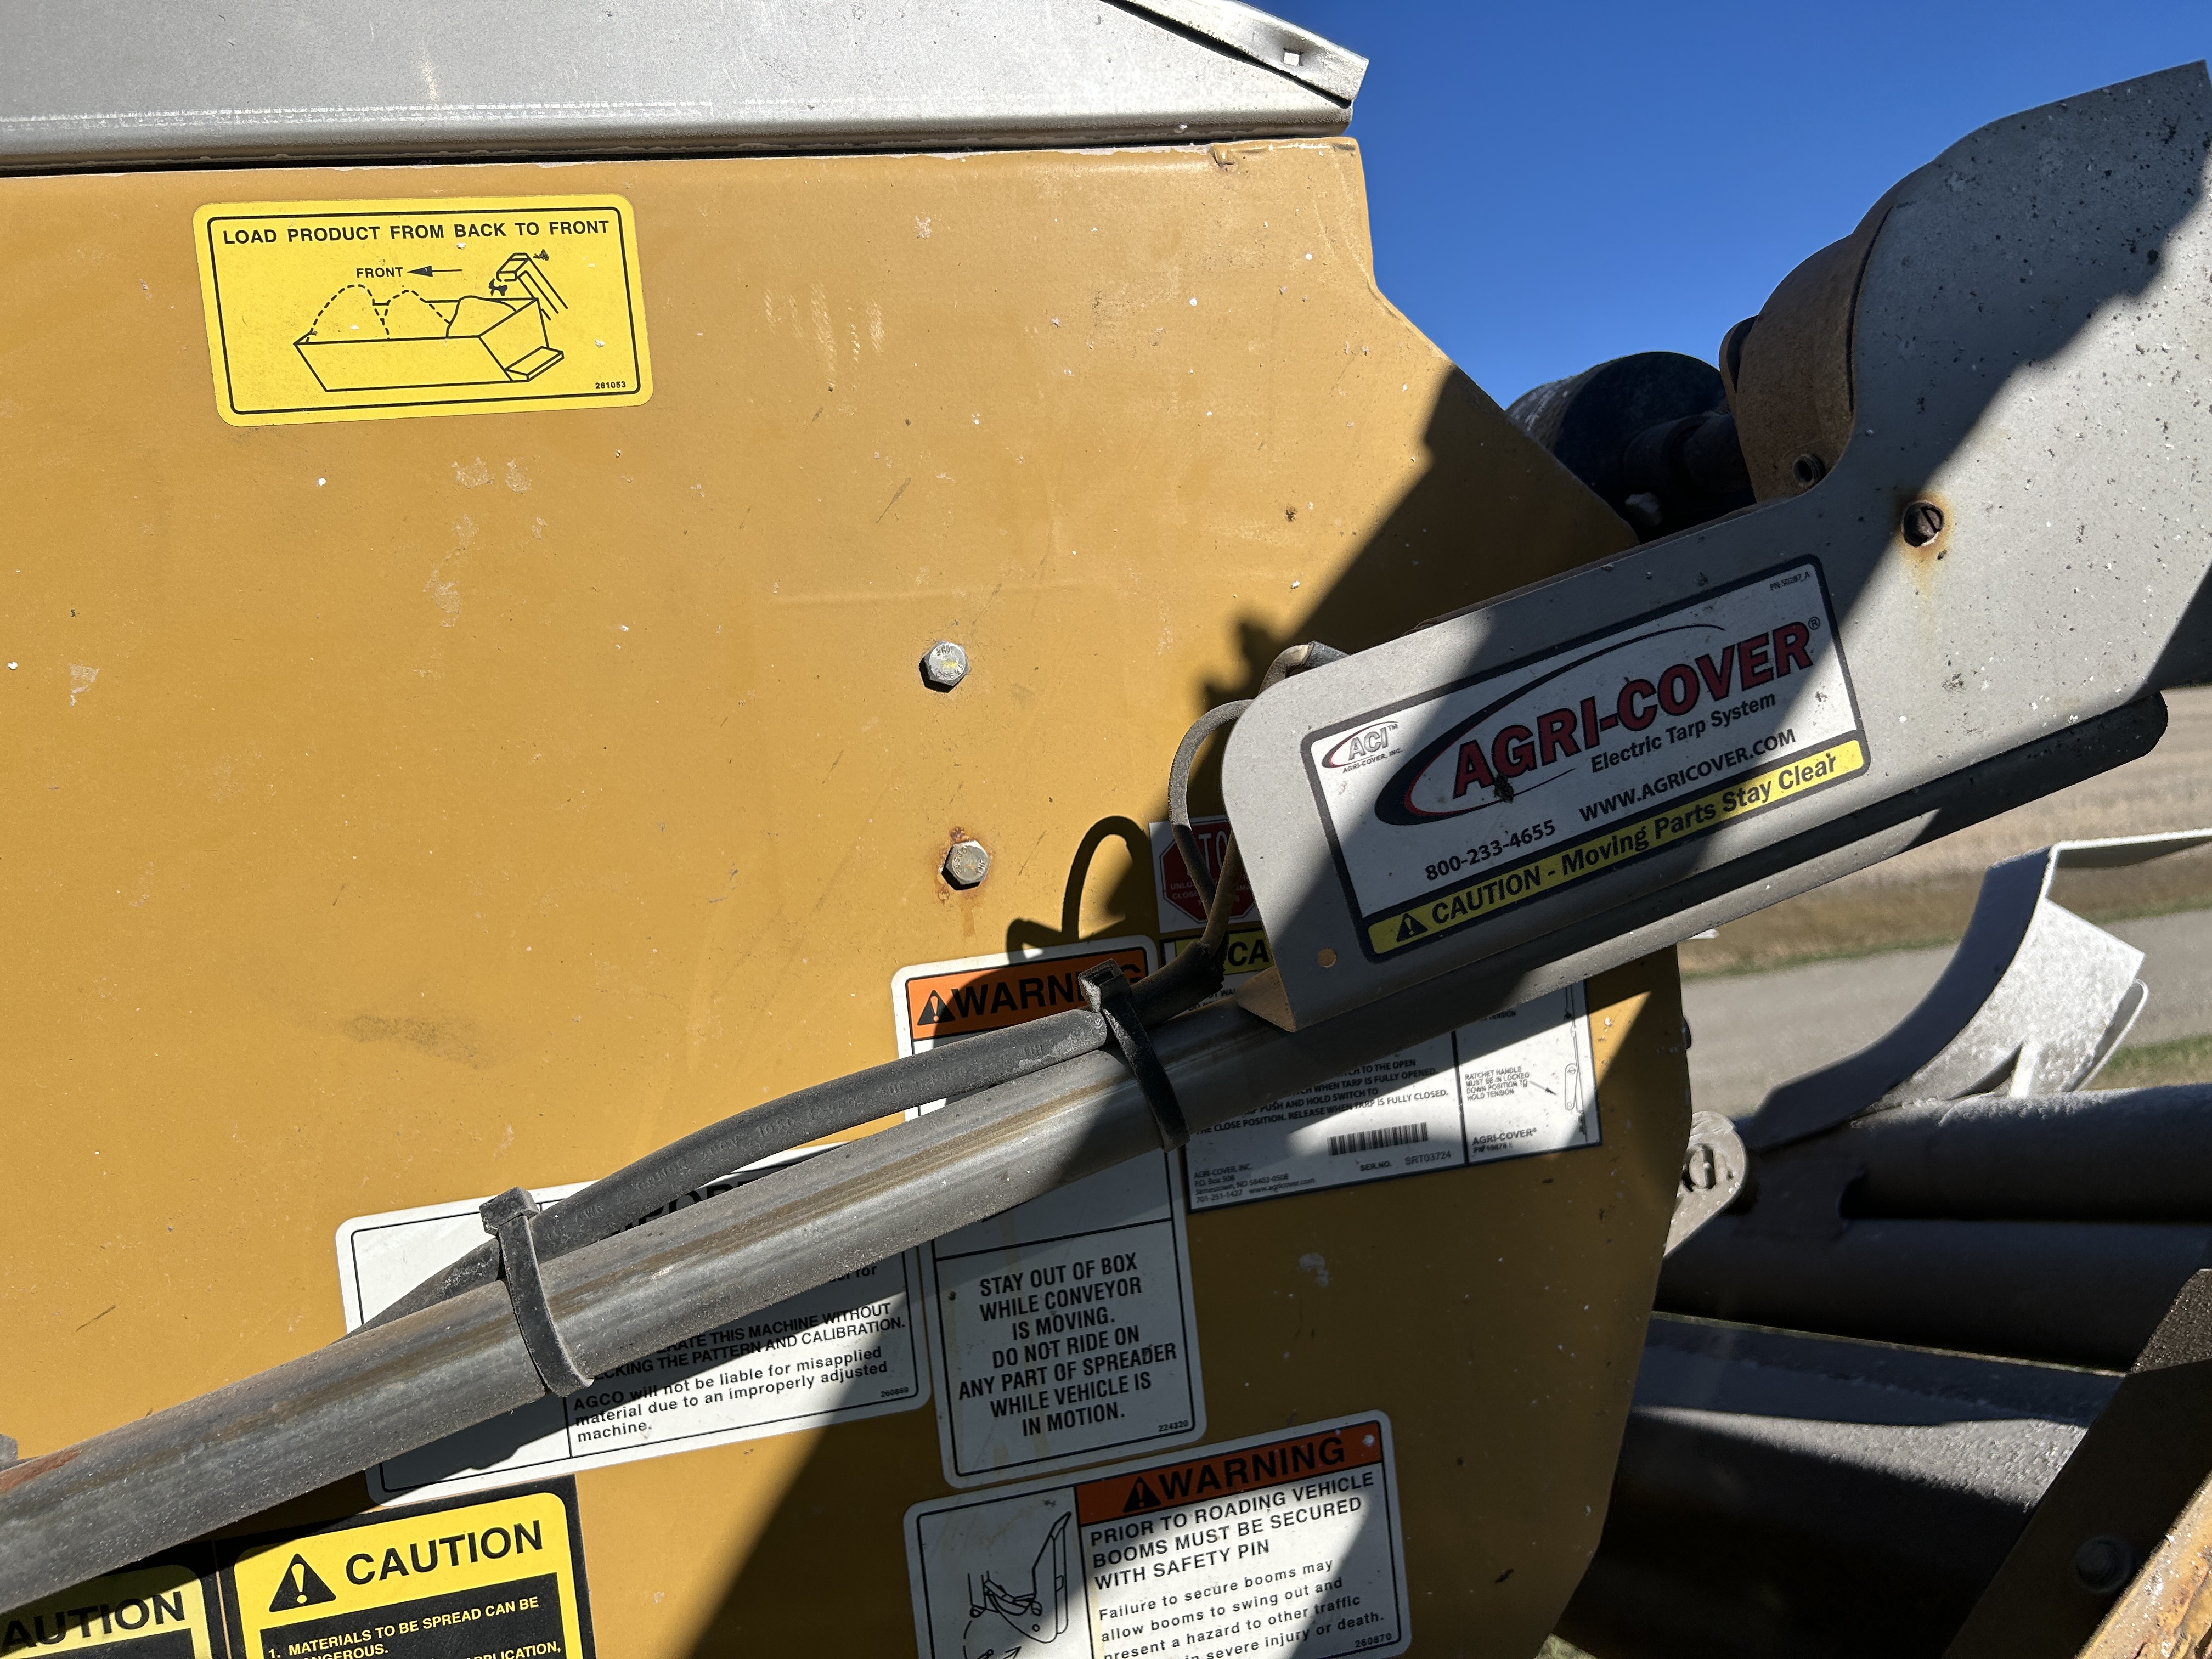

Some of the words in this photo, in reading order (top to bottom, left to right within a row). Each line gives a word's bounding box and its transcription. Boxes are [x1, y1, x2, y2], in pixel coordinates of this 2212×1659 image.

[223, 229, 277, 244] LOAD
[287, 226, 380, 242] PRODUCT
[390, 224, 444, 239] FROM
[454, 223, 507, 238] BACK
[514, 222, 539, 236] TO
[549, 220, 609, 235] FRONT
[356, 267, 403, 278] FRONT
[595, 381, 627, 390] 261053
[1590, 736, 1662, 774] Electric
[1664, 720, 1706, 744] Tarp
[1710, 693, 1776, 728] System
[1578, 728, 1796, 822] WWW.AGRICOVER.COM
[1425, 819, 1555, 881] 800-233-4655
[1432, 865, 1541, 924] CAUTION
[1561, 825, 1650, 876] Moving
[1654, 804, 1717, 840] Parts
[1722, 781, 1771, 812] Stay
[1779, 756, 1836, 790] Clear
[951, 963, 1141, 1018] WARNG
[1313, 1081, 1340, 1093] WHEN
[1340, 1077, 1363, 1088] TARP
[1364, 1076, 1373, 1085] IS
[1374, 1072, 1400, 1084] FULLY
[1401, 1068, 1438, 1080] OPENED.
[1361, 1065, 1373, 1074] TO
[1373, 1062, 1391, 1072] THE
[1392, 1059, 1416, 1069] OPEN
[1465, 1070, 1494, 1080] RATCHET
[1496, 1065, 1522, 1076] HANDLE
[1213, 1120, 1242, 1132] CLOSE
[1242, 1113, 1288, 1127] POSITION.
[1288, 1107, 1325, 1120] RELEASE
[1326, 1103, 1353, 1114] WHEN
[1353, 1100, 1375, 1109] TARP
[1377, 1098, 1385, 1106] IS
[1387, 1094, 1412, 1105] FULLY
[1414, 1089, 1449, 1101] CLOSED.
[1260, 1101, 1284, 1113] PUSH
[1285, 1098, 1305, 1109] AND
[1306, 1094, 1331, 1105] HOLD
[1333, 1090, 1365, 1102] SWITCH
[1366, 1087, 1379, 1096] TO
[1466, 1092, 1485, 1102] HOLD
[1486, 1088, 1514, 1098] TENSION
[979, 1272, 1023, 1297] STAY
[1030, 1265, 1066, 1288] OUT
[1073, 1260, 1095, 1280] OF
[1101, 1252, 1138, 1275] BOX
[979, 1294, 1039, 1322] WHILE
[1044, 1276, 1142, 1310] CONVEYOR
[1012, 1321, 1030, 1340] IS
[1035, 1306, 1115, 1336] MOVING.
[656, 1353, 689, 1369] THE
[692, 1340, 763, 1364] PATTERN
[765, 1335, 797, 1351] AND
[802, 1317, 905, 1345] CALIBRATION.
[709, 1328, 746, 1345] THIS
[748, 1315, 819, 1338] MACHINE
[821, 1302, 891, 1325] WITHOUT
[992, 1347, 1018, 1369] DO
[1024, 1339, 1060, 1363] NOT
[1066, 1330, 1109, 1355] RIDE
[1114, 1325, 1139, 1346] ON
[573, 1391, 624, 1411] AGCO
[628, 1385, 658, 1402] will
[663, 1380, 690, 1395] not
[695, 1378, 714, 1390] be
[720, 1368, 763, 1385] liable
[768, 1365, 791, 1376] for
[797, 1345, 882, 1372] misapplied
[575, 1403, 642, 1426] material
[648, 1401, 678, 1413] due
[682, 1396, 698, 1407] to
[705, 1392, 723, 1404] an
[729, 1375, 814, 1400] improperly
[821, 1361, 887, 1384] adjusted
[958, 1376, 995, 1400] ANY
[1001, 1366, 1048, 1392] PART
[1054, 1361, 1077, 1382] OF
[1082, 1342, 1177, 1376] SPREADER
[989, 1390, 1049, 1418] WHILE
[1053, 1375, 1129, 1406] VEHICLE
[1134, 1371, 1152, 1391] IS
[578, 1422, 652, 1442] machine.
[1022, 1417, 1041, 1437] IN
[1047, 1401, 1125, 1432] MOTION.
[1158, 1436, 1345, 1500] WARNING
[1091, 1520, 1154, 1547] PRIOR
[1160, 1513, 1187, 1531] TO
[1194, 1491, 1286, 1524] ROADING
[1292, 1471, 1374, 1502] VEHICLE
[1093, 1539, 1167, 1568] BOOMS
[1175, 1525, 1230, 1550] MUST
[1238, 1518, 1263, 1537] BE
[1270, 1497, 1361, 1529] SECURED
[346, 1520, 543, 1585] CAUTION
[1094, 1566, 1146, 1590] WITH
[1154, 1547, 1230, 1577] SAFETY
[1238, 1539, 1269, 1559] PIN
[1099, 1601, 1156, 1621] Failure
[1161, 1595, 1177, 1606] to
[1184, 1582, 1238, 1601] secure
[1244, 1569, 1296, 1588] booms
[1303, 1560, 1333, 1575] may
[1101, 1625, 1143, 1643] allow
[1150, 1611, 1204, 1631] booms
[1210, 1606, 1226, 1617] to
[1233, 1594, 1278, 1612] swing
[1284, 1585, 1309, 1600] out
[1315, 1577, 1343, 1593] and
[268, 1648, 281, 1659] 1.
[289, 1629, 372, 1656] MATERIALS
[374, 1625, 396, 1639] TO
[398, 1620, 419, 1634] BE
[422, 1608, 482, 1629] SPREAD
[485, 1600, 516, 1617] CAN
[519, 1596, 539, 1611] BE
[1172, 1639, 1180, 1648] a
[1187, 1622, 1240, 1645] hazard
[1247, 1620, 1261, 1630] to
[1268, 1609, 1308, 1625] other
[1314, 1595, 1361, 1615] traffic
[1206, 1641, 1259, 1659] severe
[1265, 1629, 1310, 1647] injury
[1316, 1624, 1331, 1635] or
[1337, 1611, 1384, 1630] death.
[1354, 1633, 1391, 1649] 260870
